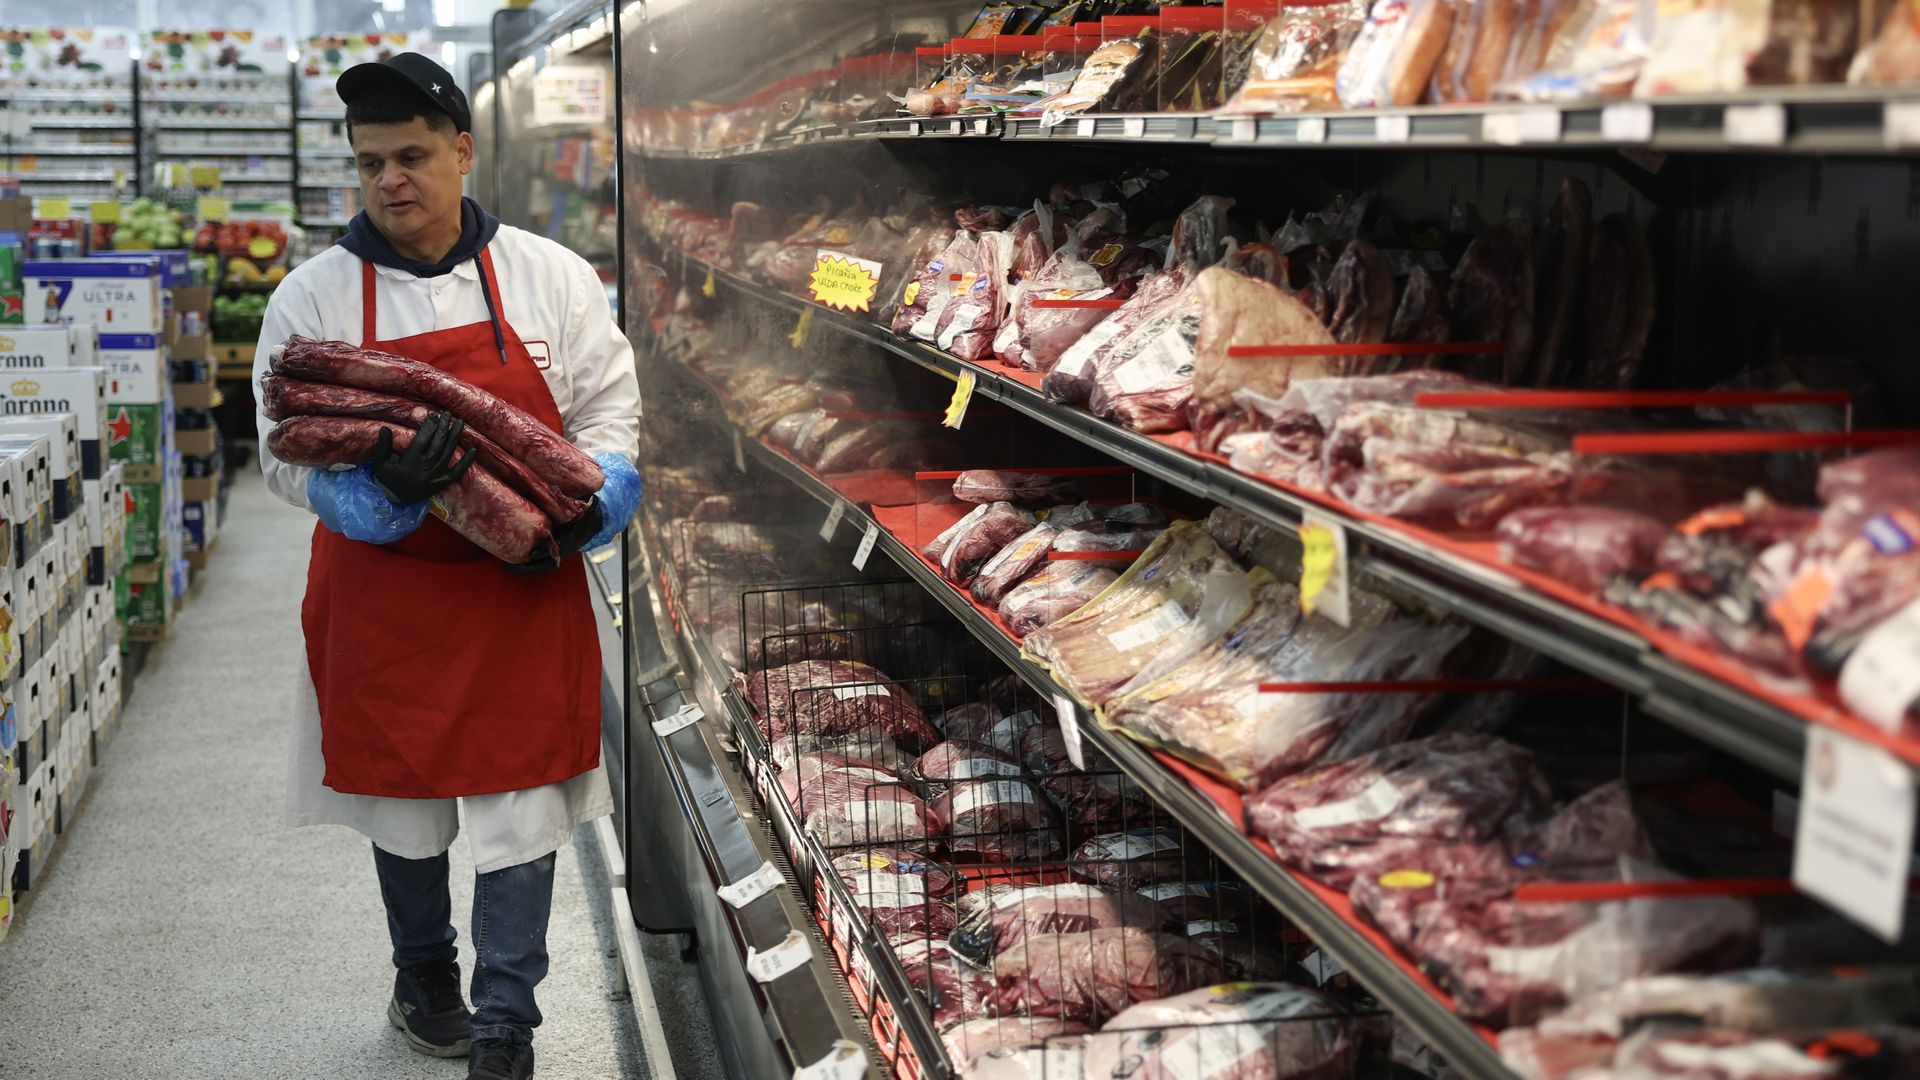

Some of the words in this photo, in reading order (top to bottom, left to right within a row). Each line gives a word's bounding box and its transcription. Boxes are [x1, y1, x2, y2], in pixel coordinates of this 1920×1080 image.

[82, 290, 136, 303] ULTRA
[0, 355, 45, 369] rona
[110, 362, 142, 374] TRA
[0, 393, 70, 416] orona
